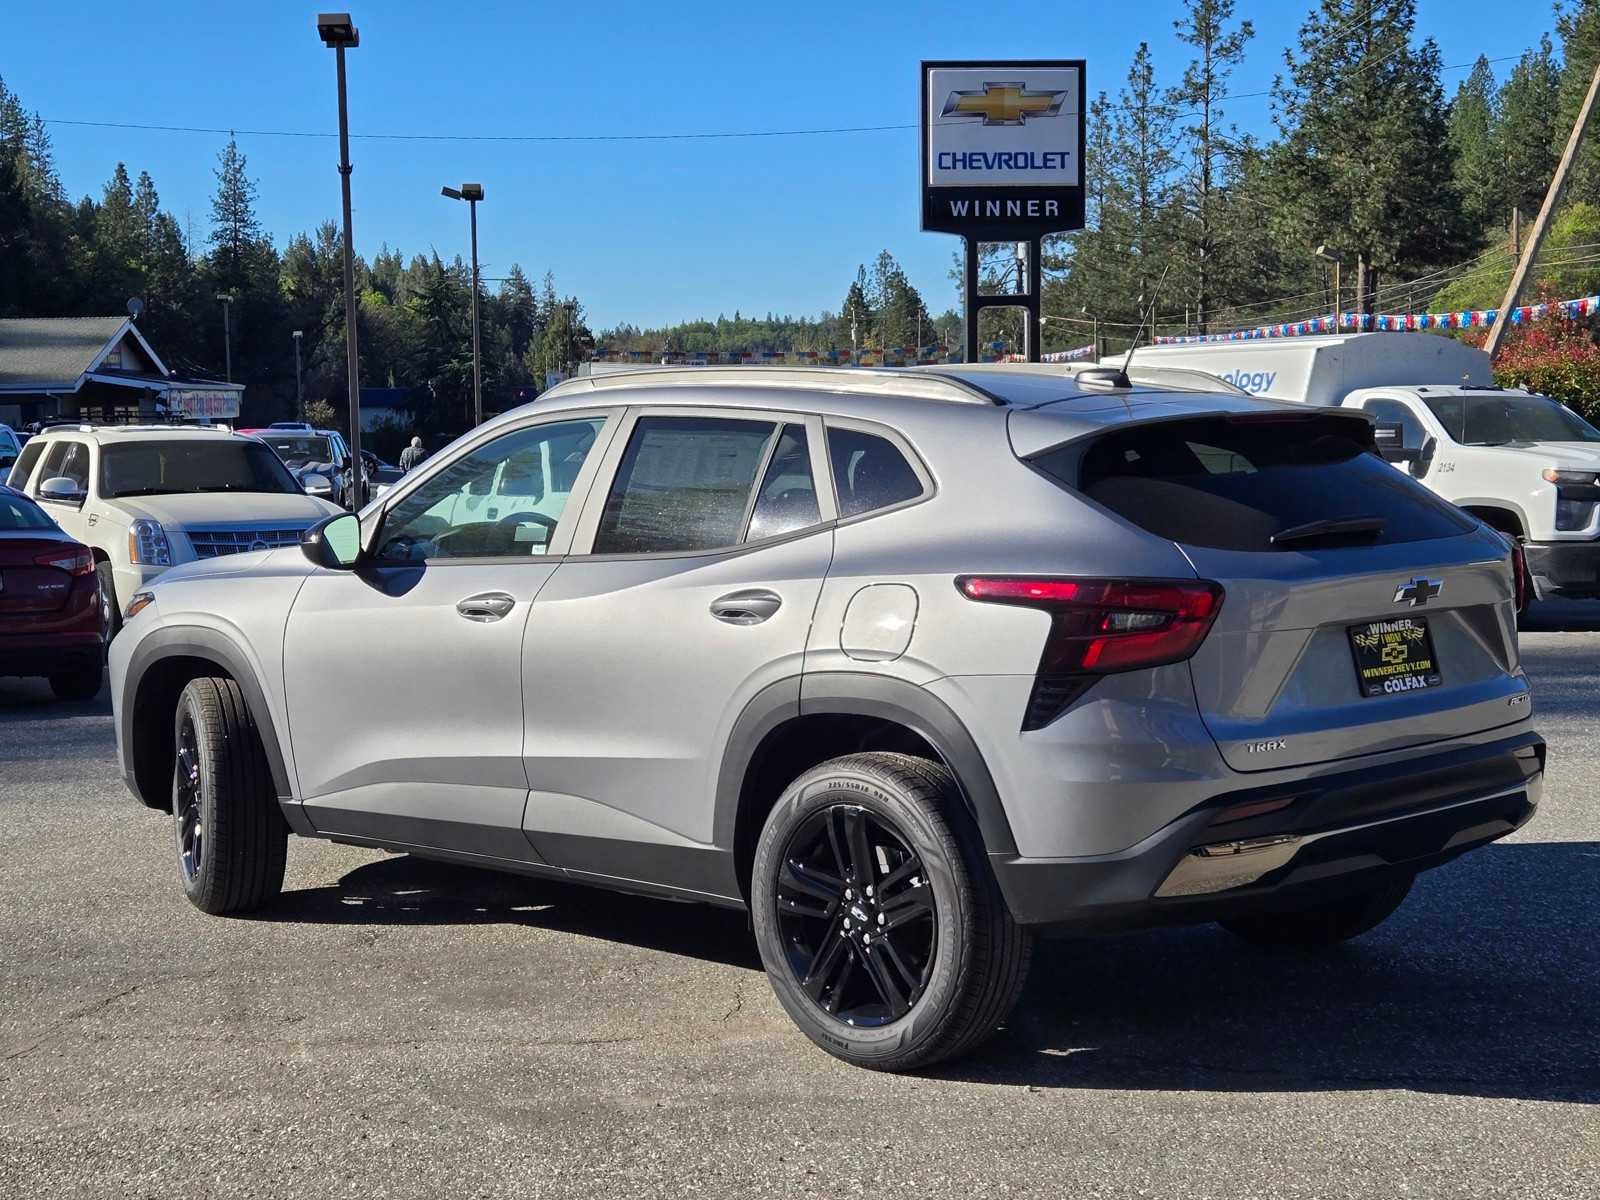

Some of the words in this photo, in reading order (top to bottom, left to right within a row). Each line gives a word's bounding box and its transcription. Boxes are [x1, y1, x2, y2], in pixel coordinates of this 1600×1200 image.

[938, 151, 1070, 170] CHEVROLET
[950, 200, 1059, 217] WINNER
[1217, 369, 1277, 393] ology
[1369, 619, 1412, 635] WINNER
[1363, 660, 1431, 678] WINNERCHEVY.COM
[1384, 675, 1427, 693] COLFAX
[1247, 738, 1287, 753] TRAX
